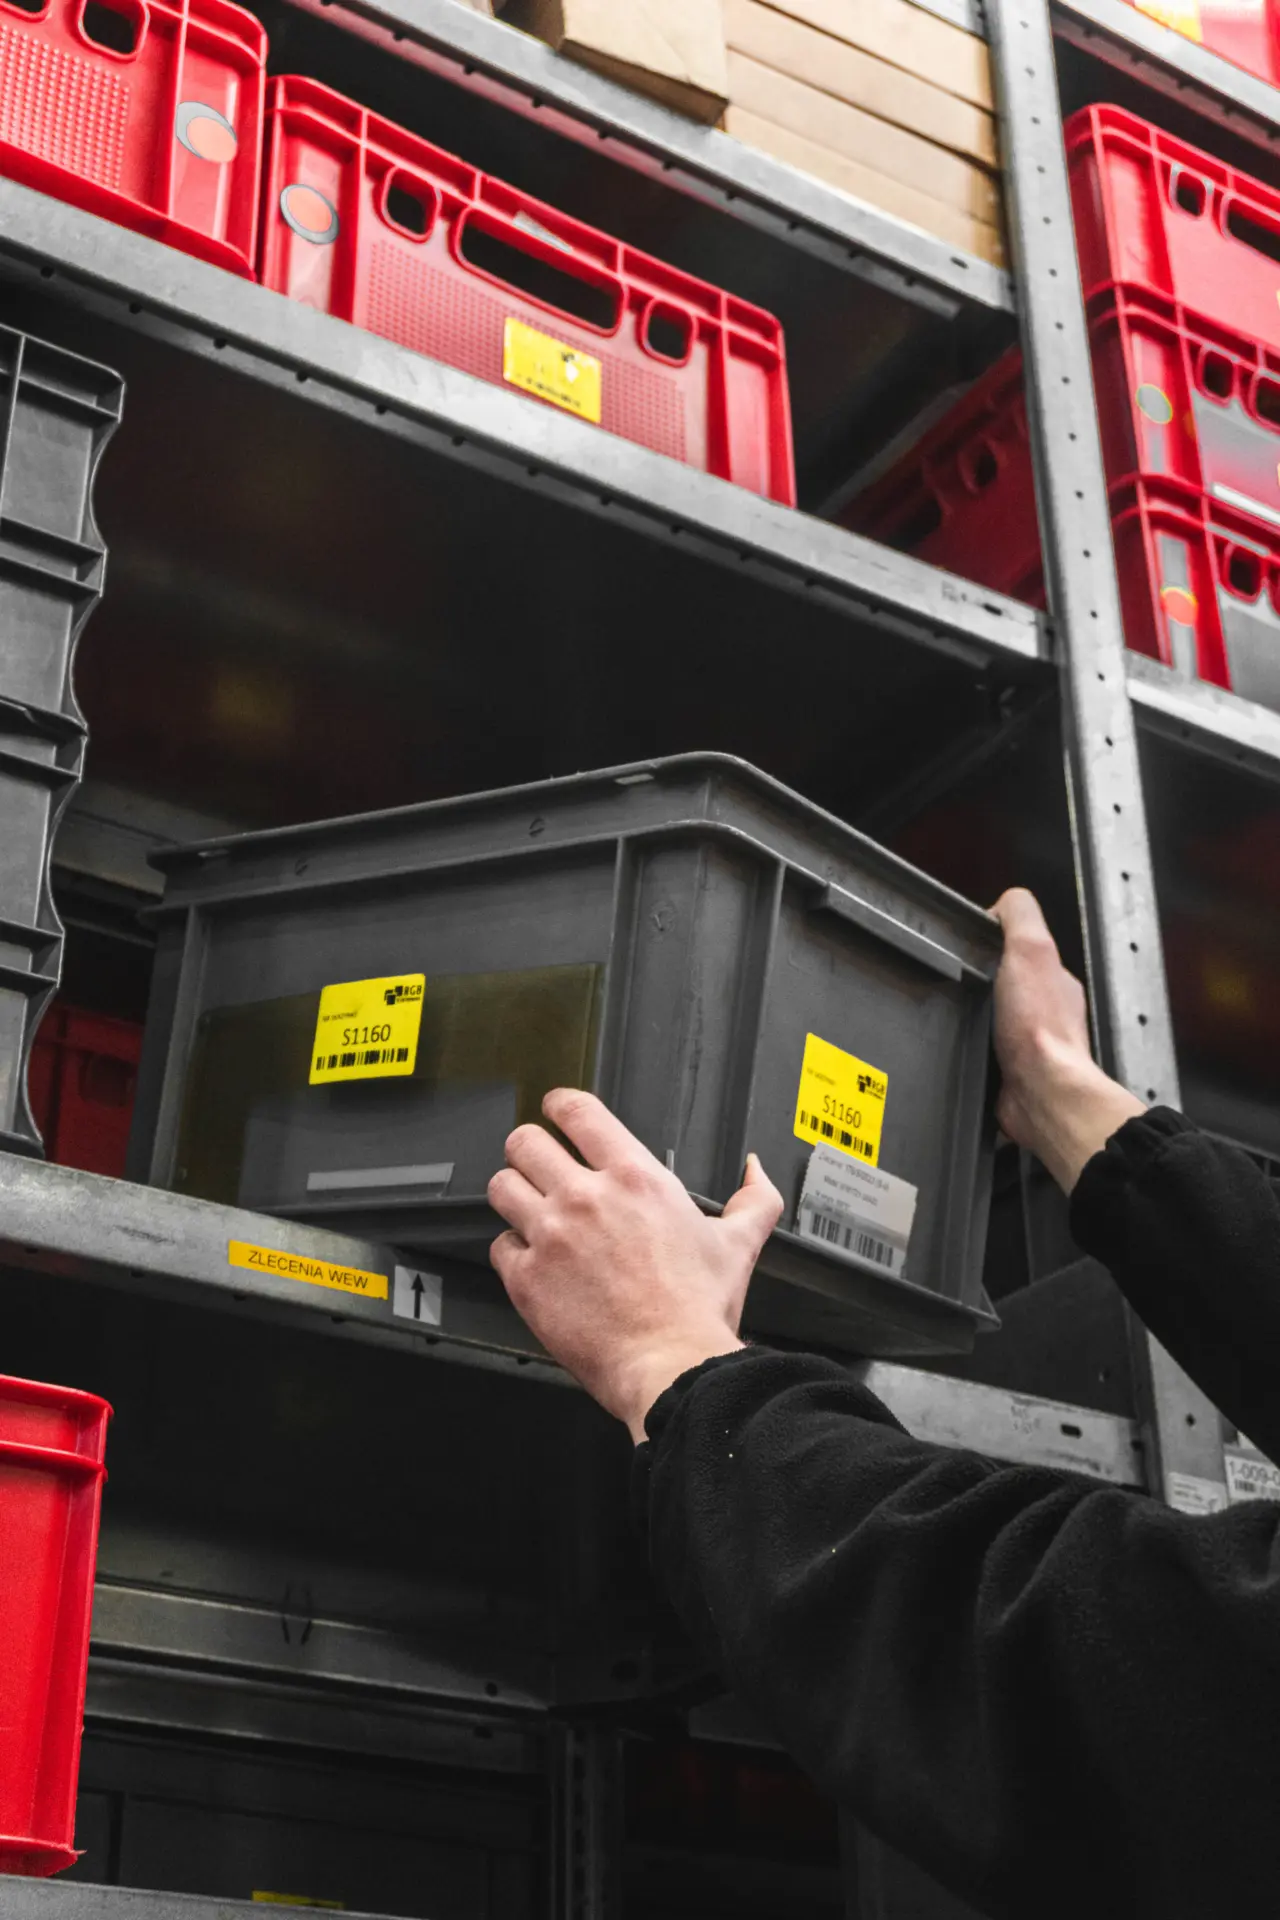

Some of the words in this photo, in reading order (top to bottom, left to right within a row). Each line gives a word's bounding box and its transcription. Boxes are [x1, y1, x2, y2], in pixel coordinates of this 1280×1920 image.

[403, 985, 422, 996] RGB
[342, 1024, 391, 1046] S1160
[822, 1094, 861, 1129] S1160
[248, 1250, 324, 1280] ZLECENIA
[328, 1269, 369, 1289] WEW
